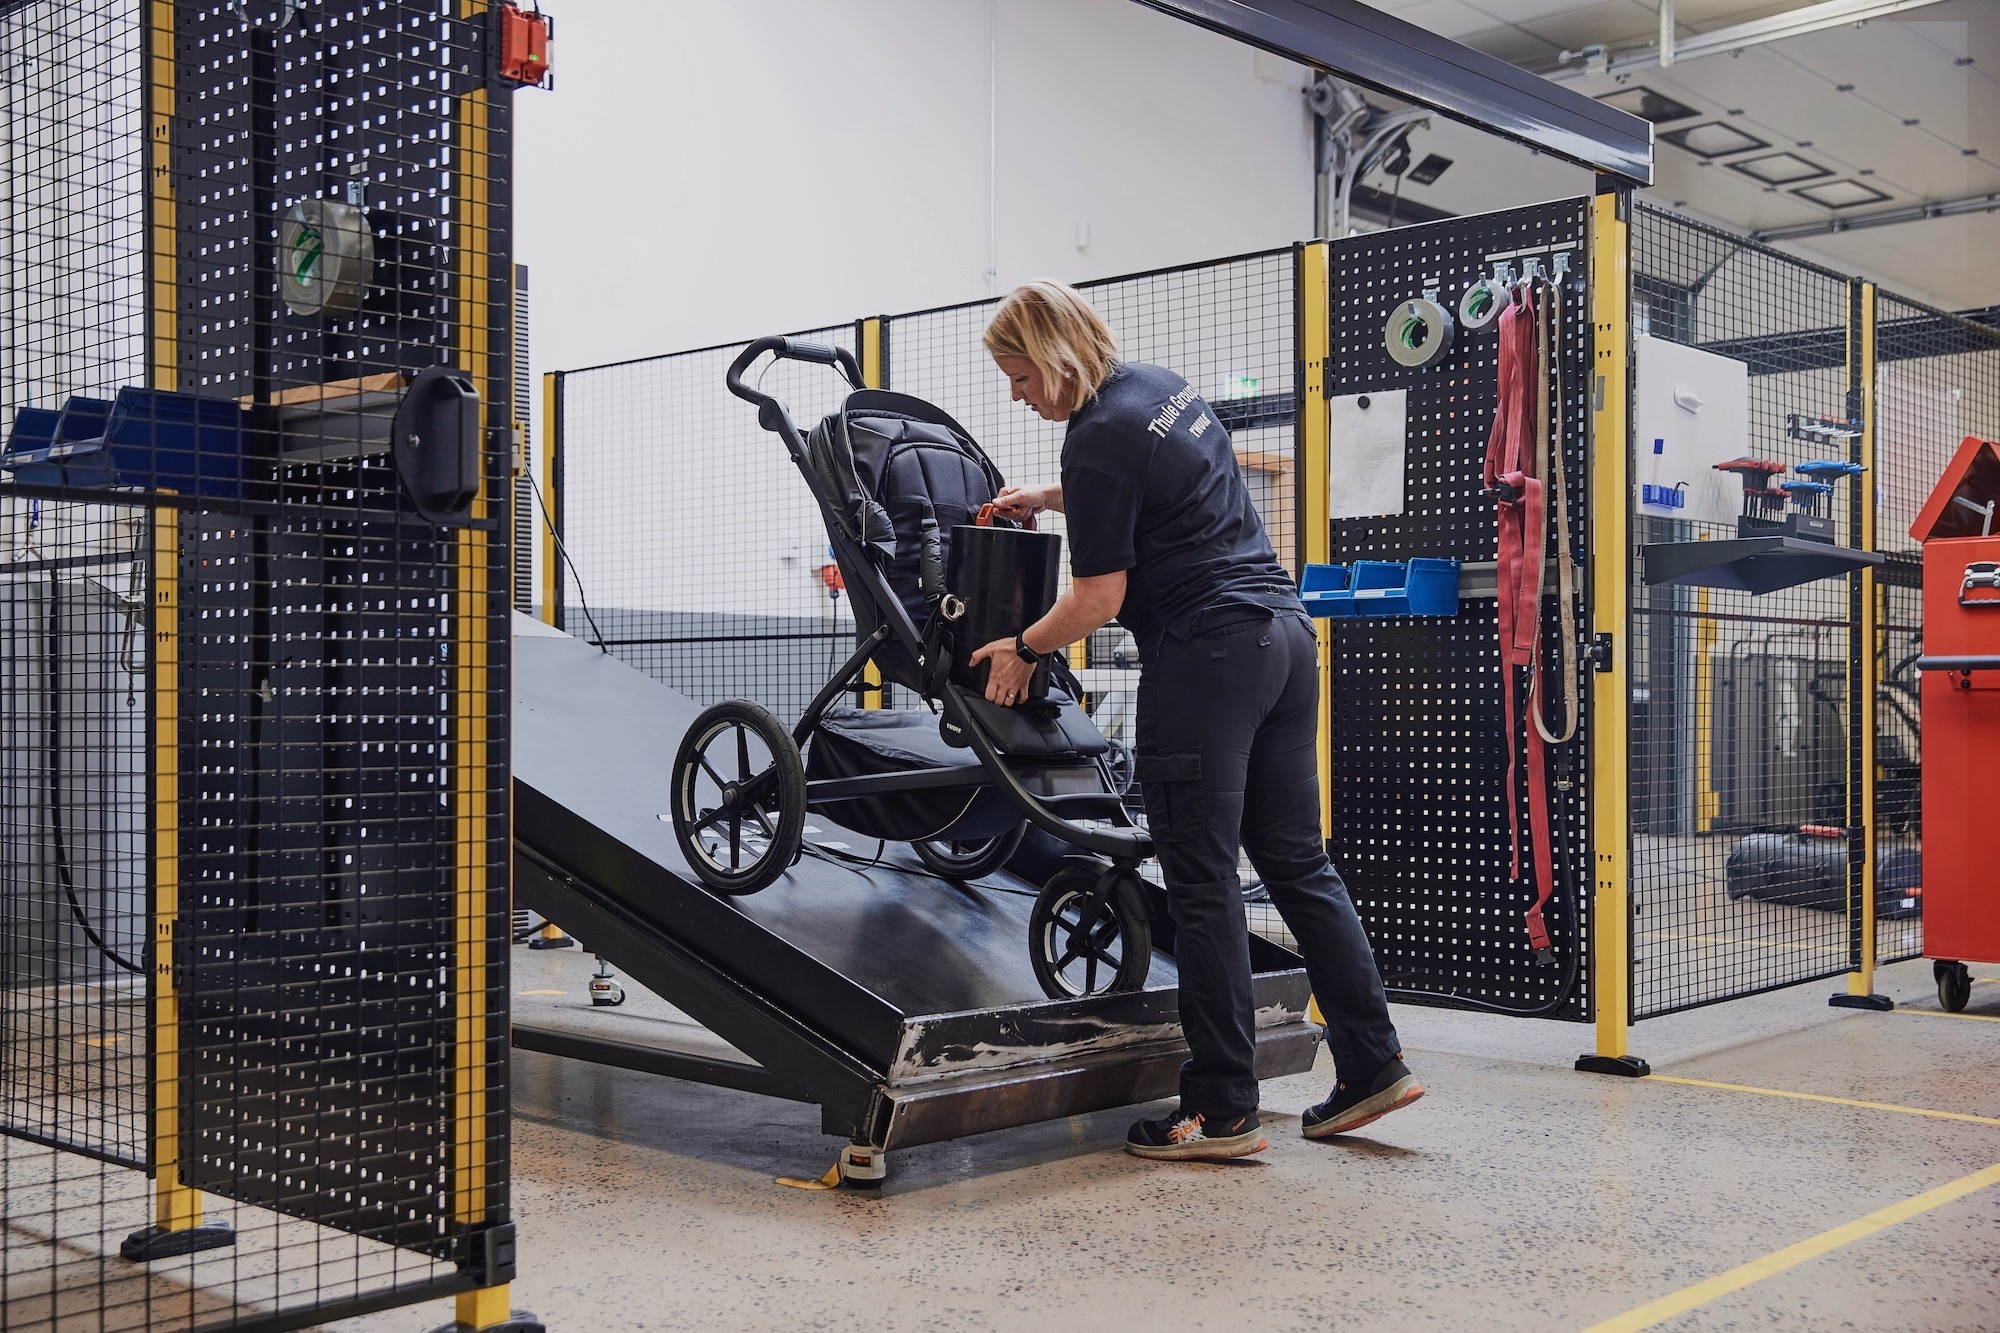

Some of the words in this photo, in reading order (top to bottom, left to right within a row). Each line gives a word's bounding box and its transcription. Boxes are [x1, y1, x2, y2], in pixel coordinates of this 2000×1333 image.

[1147, 403, 1180, 438] Thule
[1169, 385, 1200, 411] Group
[1188, 412, 1212, 438] THULE
